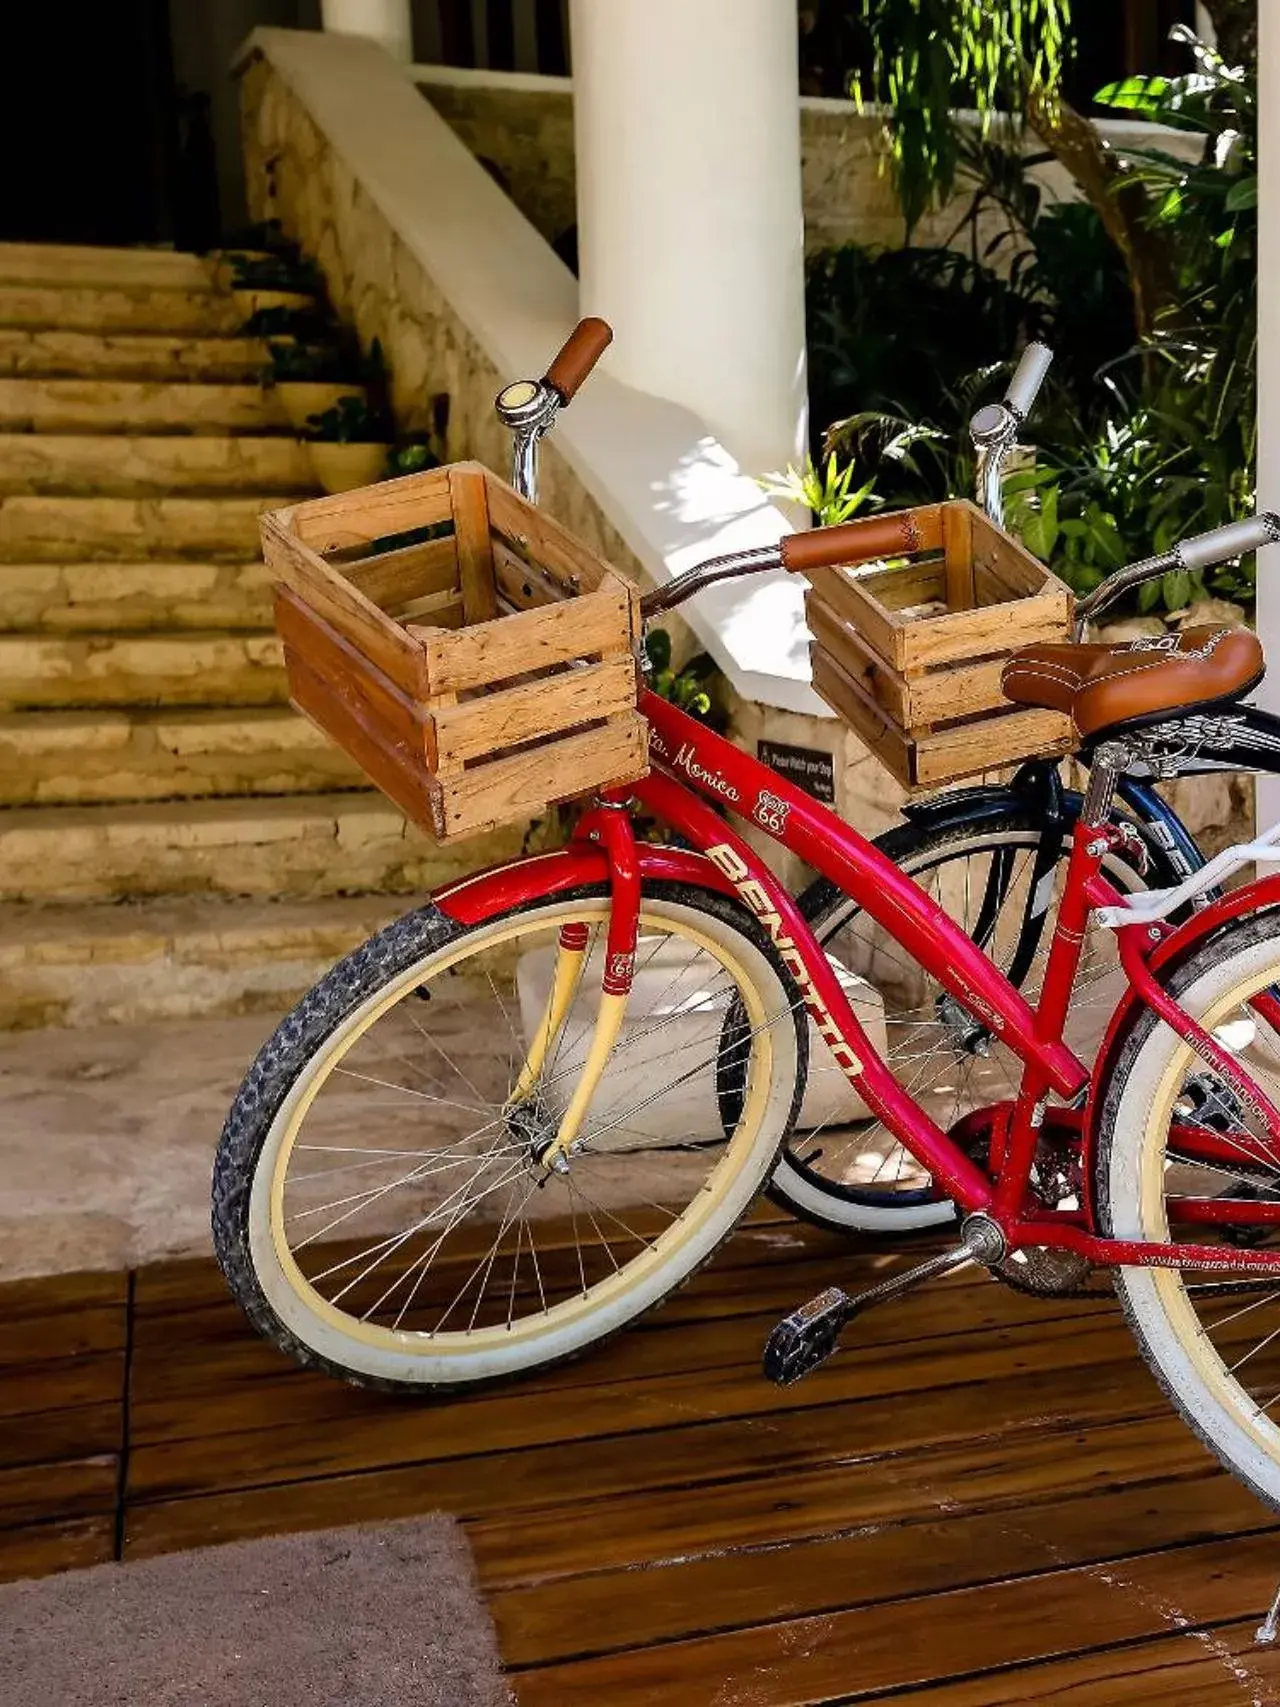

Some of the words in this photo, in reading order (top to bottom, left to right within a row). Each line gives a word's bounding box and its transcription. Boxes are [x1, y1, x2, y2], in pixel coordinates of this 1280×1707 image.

[671, 742, 741, 802] Monica
[758, 805, 780, 831] 66
[704, 843, 864, 1077] BENOTTO
